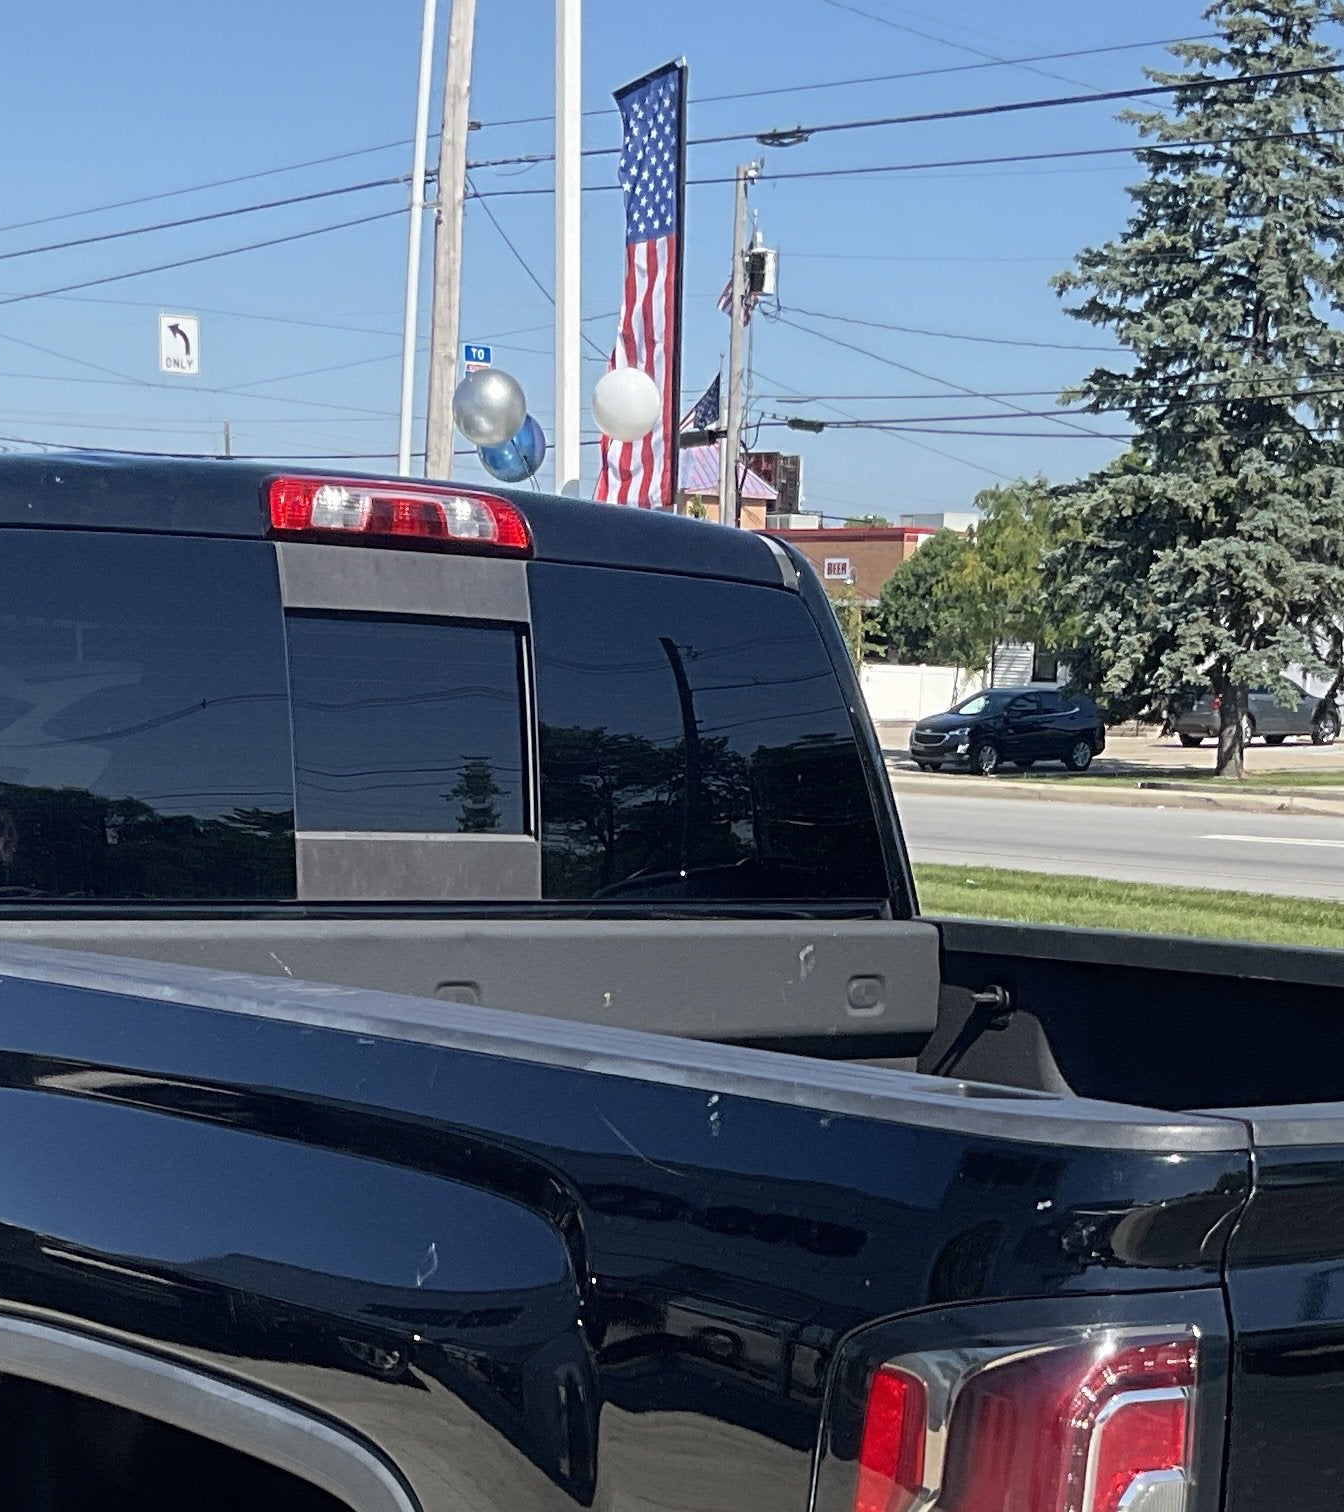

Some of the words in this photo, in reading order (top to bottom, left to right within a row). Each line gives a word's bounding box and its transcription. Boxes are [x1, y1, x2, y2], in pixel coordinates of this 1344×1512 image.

[471, 348, 485, 360] TO
[166, 357, 193, 370] ONLY
[827, 562, 847, 575] BEER
